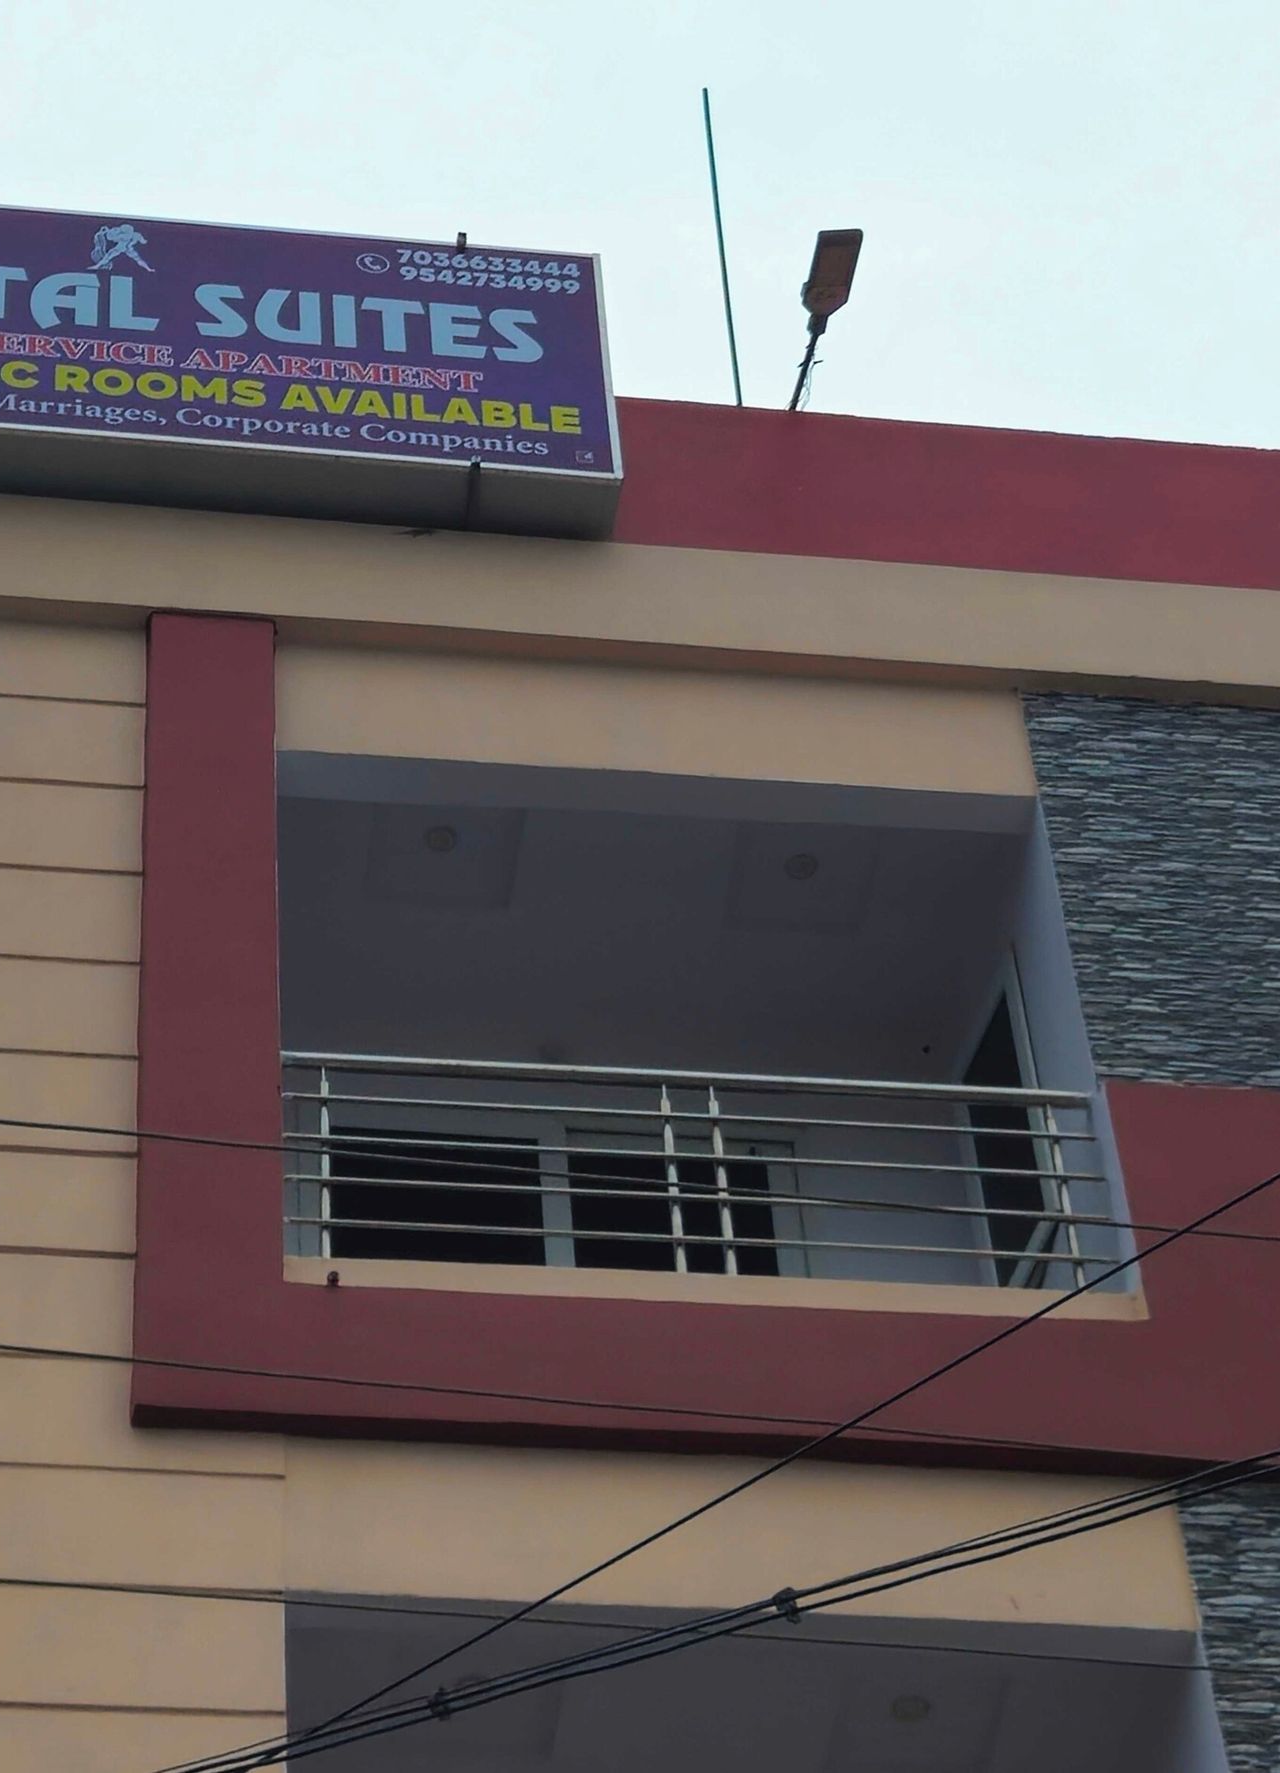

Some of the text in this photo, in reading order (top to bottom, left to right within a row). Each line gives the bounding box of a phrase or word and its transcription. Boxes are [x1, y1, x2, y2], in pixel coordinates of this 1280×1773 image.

[396, 249, 581, 278] 7036633444
[399, 266, 581, 295] 9542734999
[194, 283, 544, 364] SUITES
[180, 347, 484, 393] APARTMENT
[55, 363, 266, 408] ROOMS
[280, 383, 582, 435] AVAILABLE
[176, 407, 352, 440] Corporate
[359, 423, 549, 457] Companies
